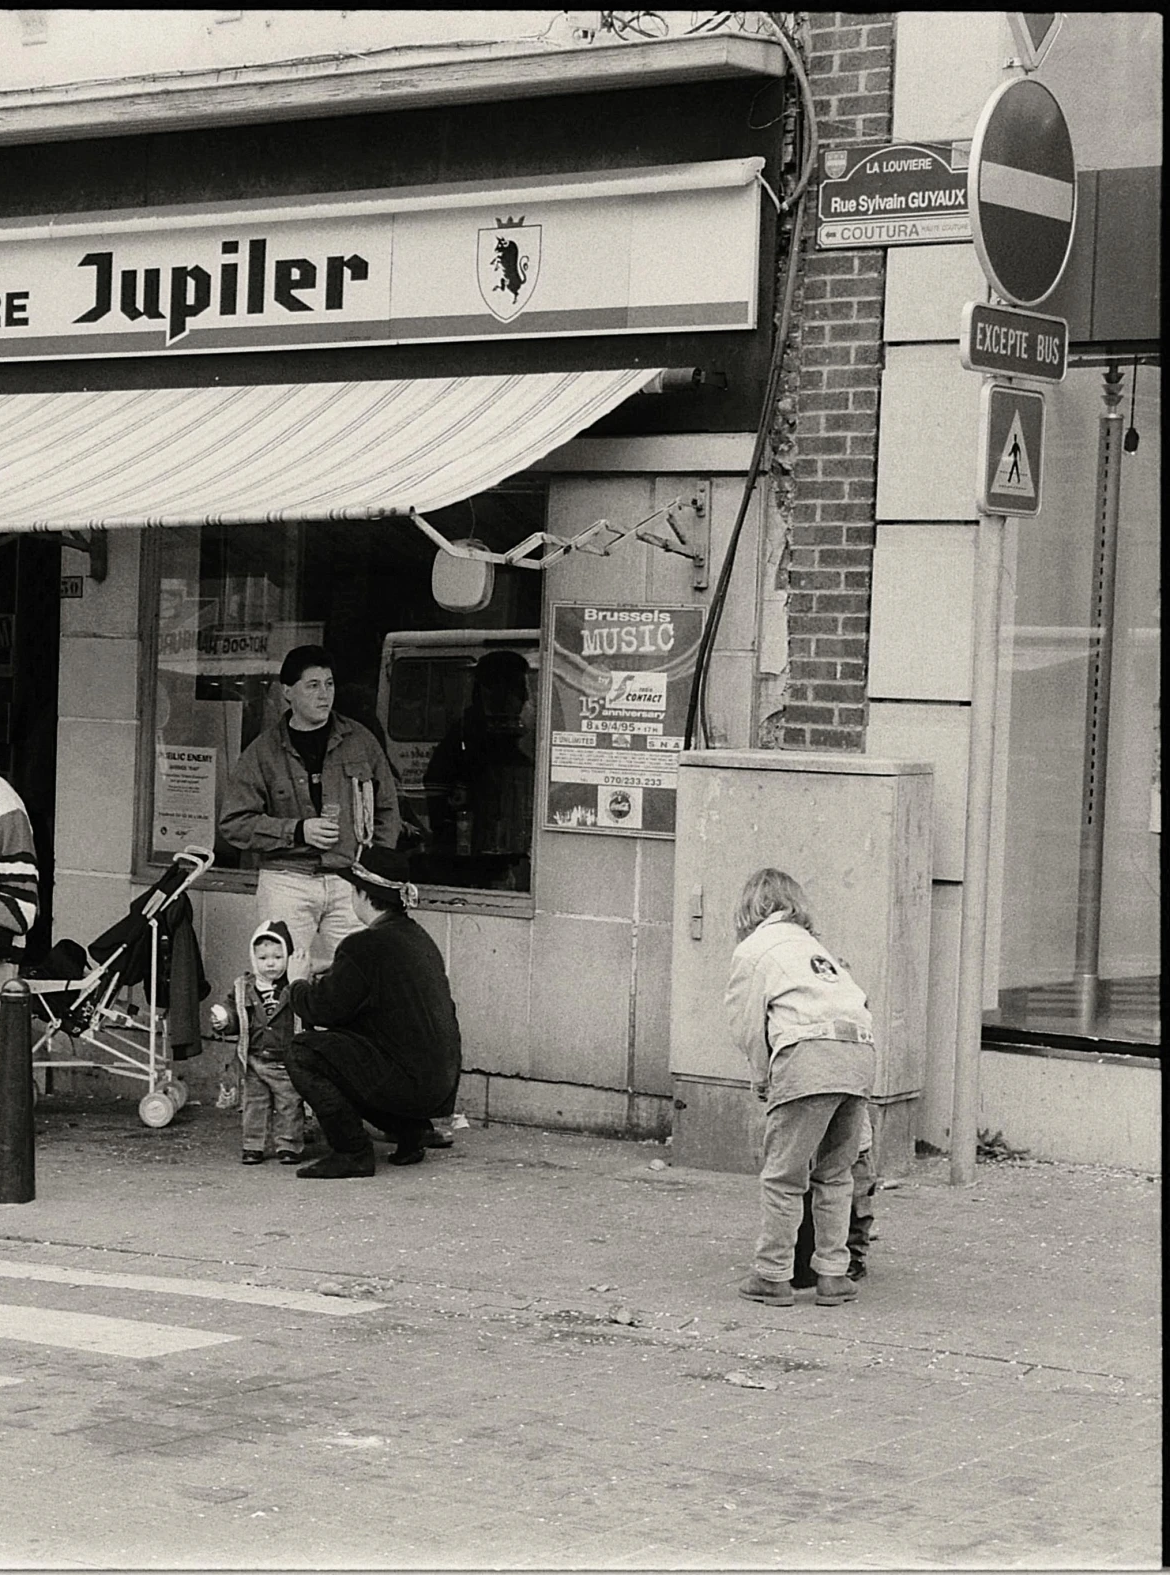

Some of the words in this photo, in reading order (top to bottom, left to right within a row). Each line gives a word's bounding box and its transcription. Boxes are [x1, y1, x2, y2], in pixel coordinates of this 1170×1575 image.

[866, 162, 879, 174] LA
[883, 158, 933, 173] LOUVIERE
[831, 197, 856, 213] Rue
[858, 193, 906, 214] Sylvain
[908, 189, 965, 209] GUYAUX
[841, 224, 919, 241] COUTURA
[72, 238, 369, 342] Jupiler
[976, 322, 1029, 359] EXCEPTE
[1037, 334, 1060, 365] BUS
[584, 608, 671, 622] Brussels
[581, 623, 675, 656] MUSIC
[598, 676, 610, 685] by
[626, 692, 662, 703] CONTACT
[602, 708, 665, 720] anniversary
[586, 721, 593, 730] 8
[601, 721, 635, 732] 9/4/95
[559, 736, 594, 745] UNLIMITED
[187, 753, 213, 763] ENEMY
